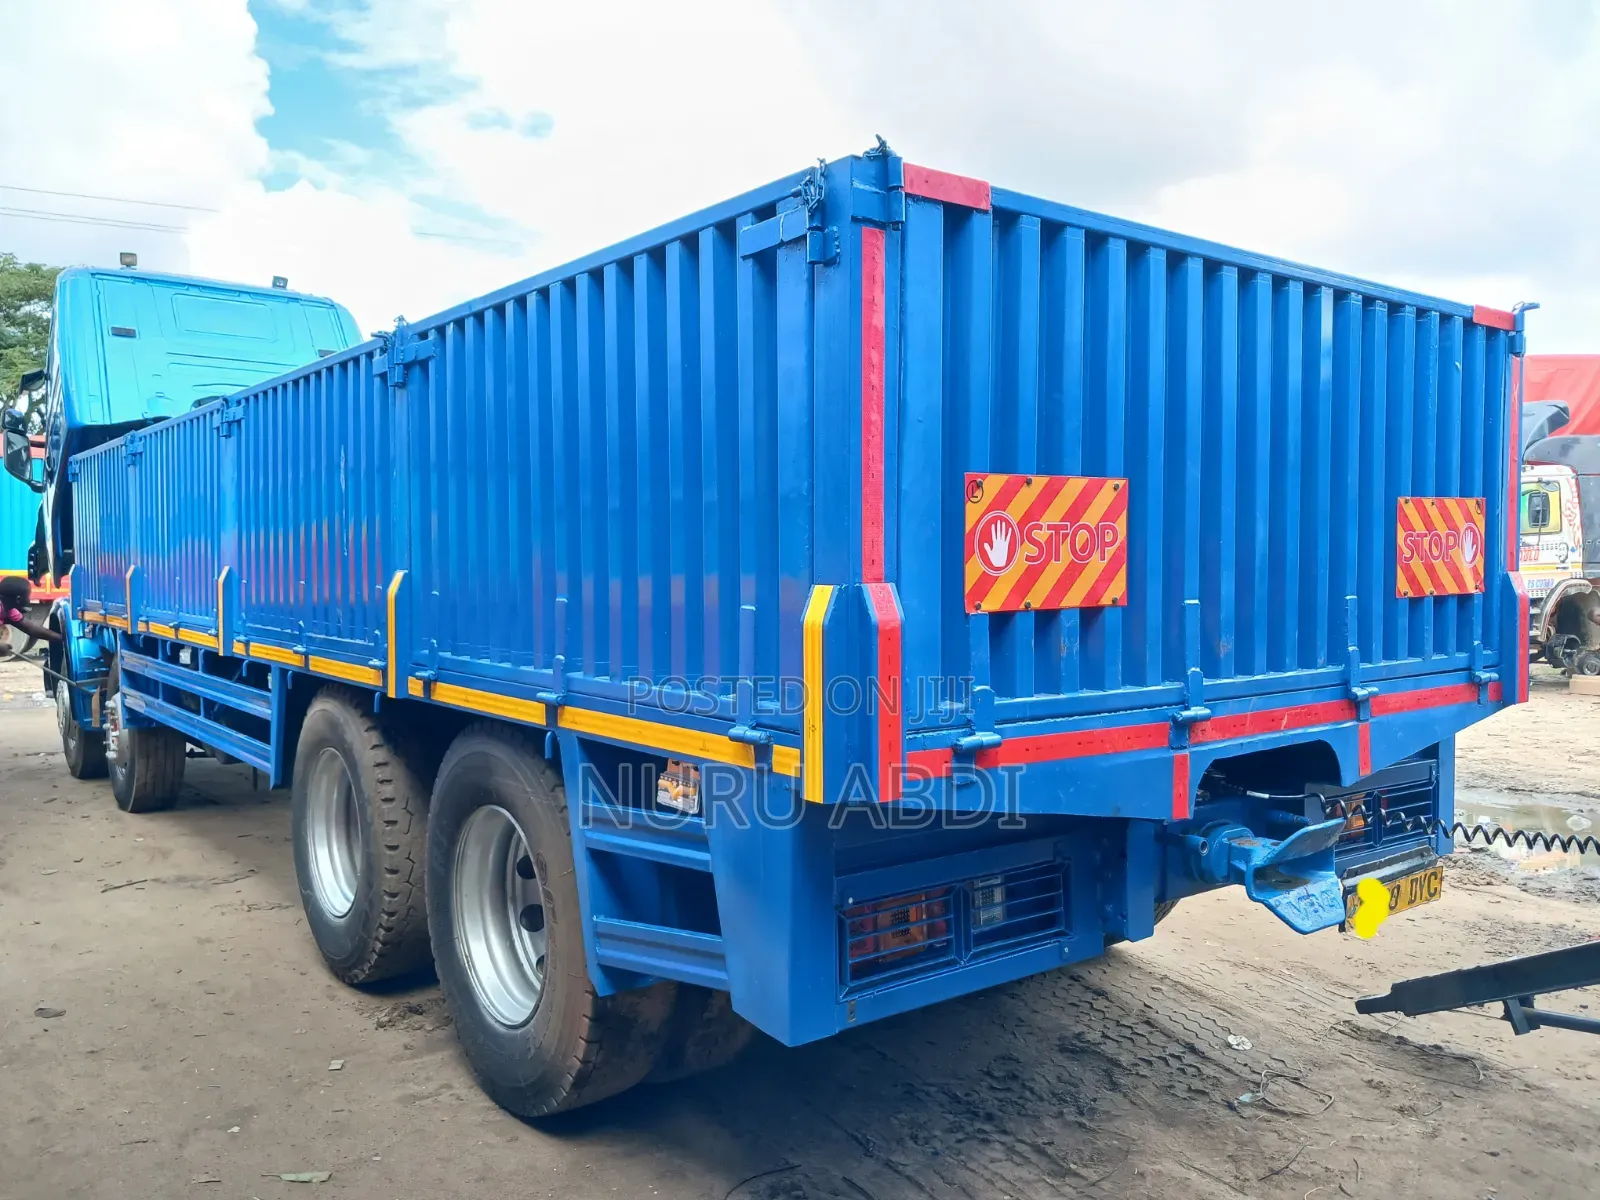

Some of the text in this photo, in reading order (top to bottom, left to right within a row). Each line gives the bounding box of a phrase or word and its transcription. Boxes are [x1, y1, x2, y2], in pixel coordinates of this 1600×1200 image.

[1024, 521, 1119, 564] STOP
[1402, 531, 1459, 563] STOP
[1408, 871, 1438, 906] DYC
